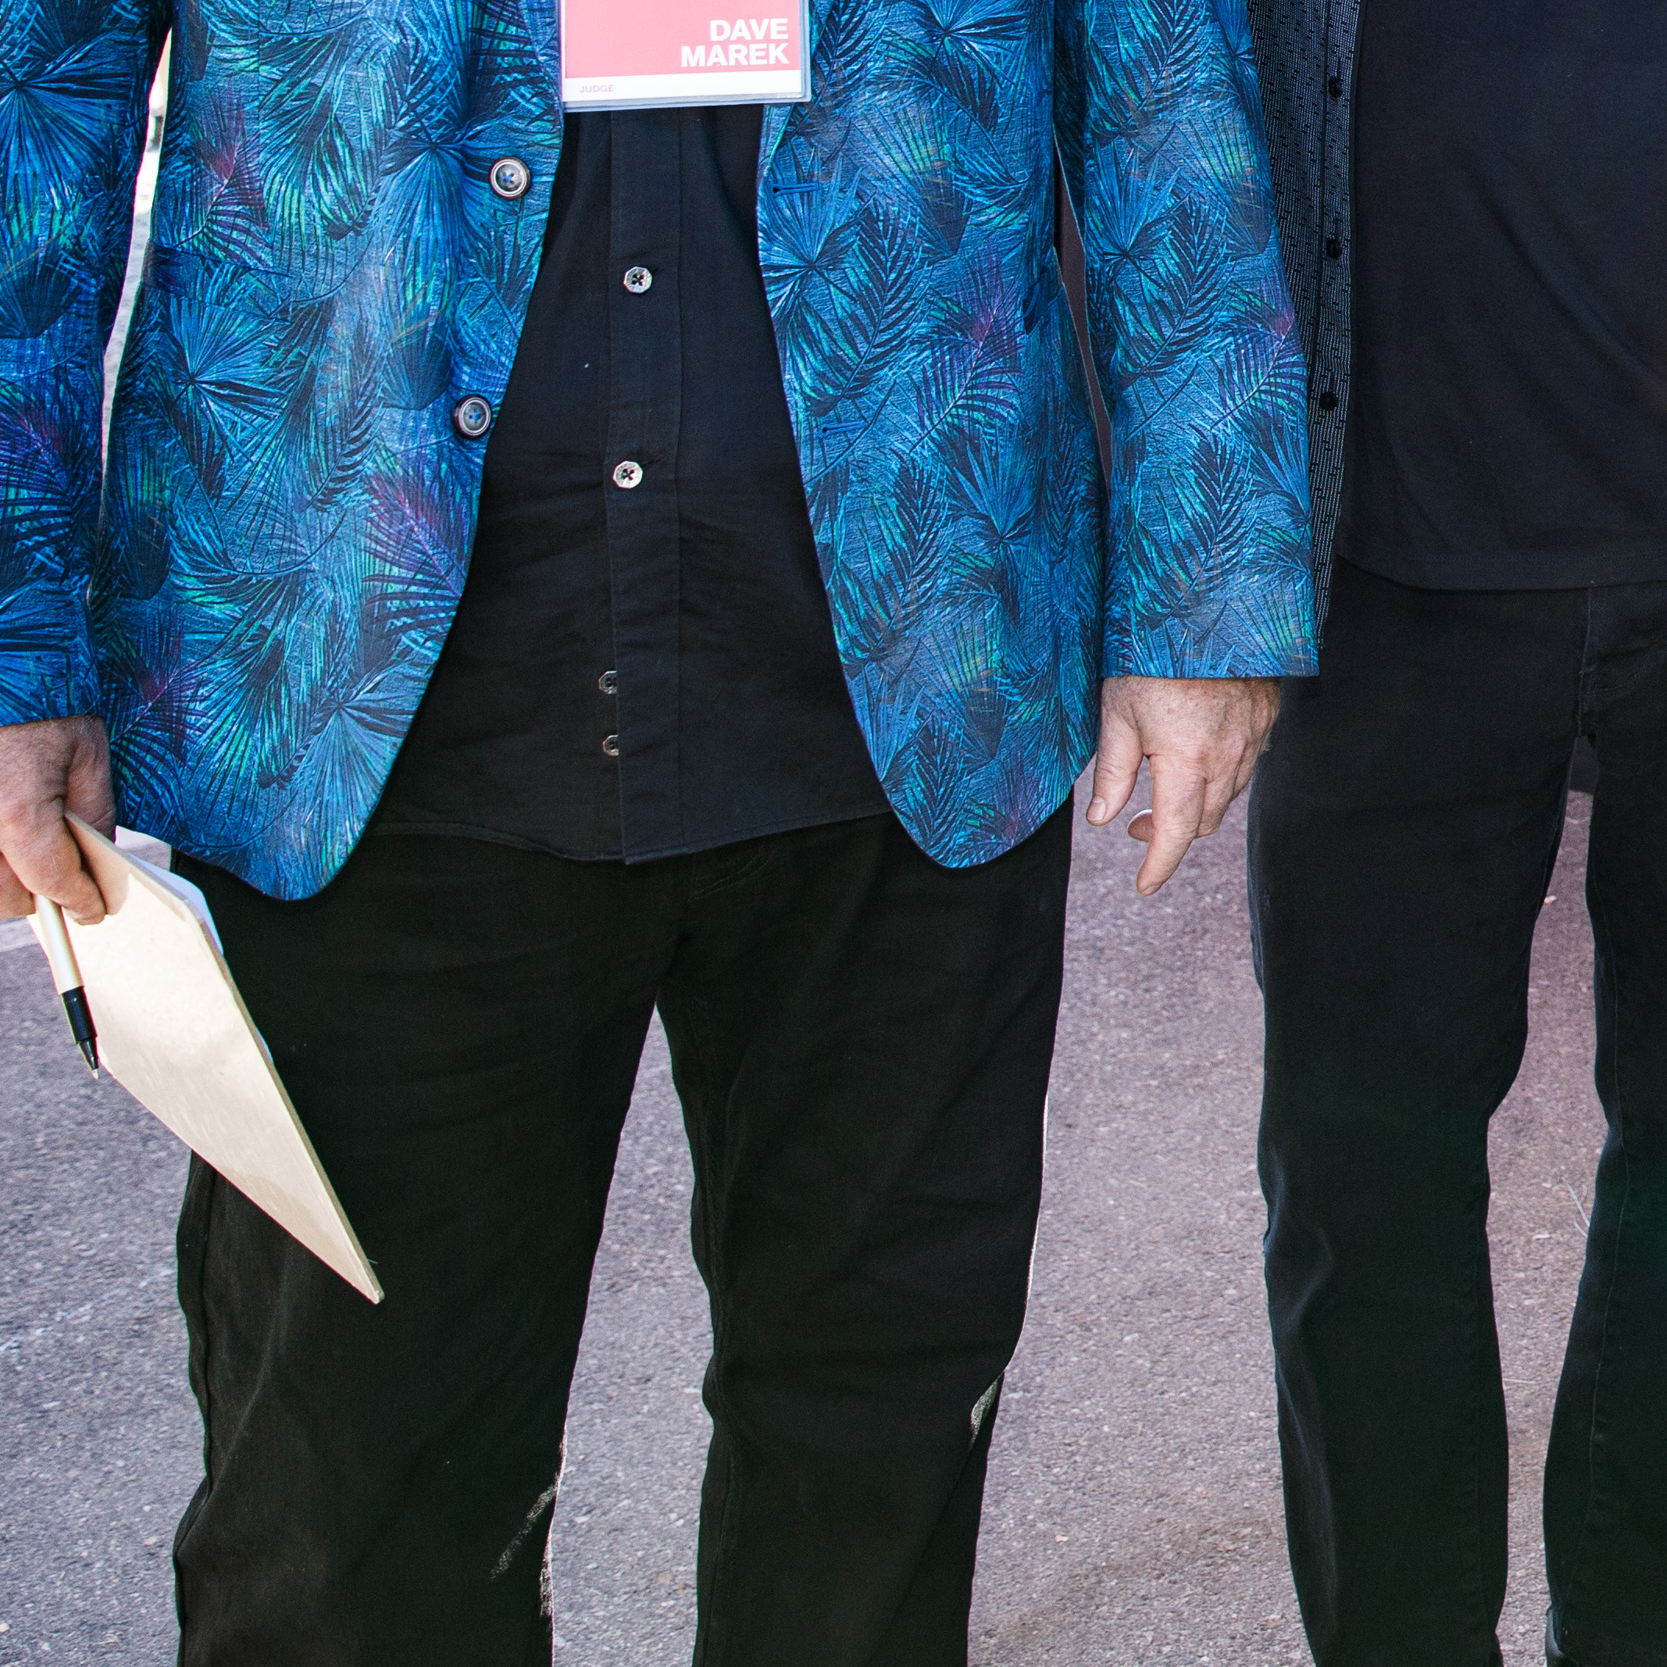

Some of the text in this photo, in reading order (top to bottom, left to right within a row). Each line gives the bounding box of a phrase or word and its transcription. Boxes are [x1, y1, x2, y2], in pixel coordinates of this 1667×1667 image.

[709, 18, 789, 42] DAVE
[680, 42, 790, 68] MAREK
[579, 84, 615, 94] JUDGE
